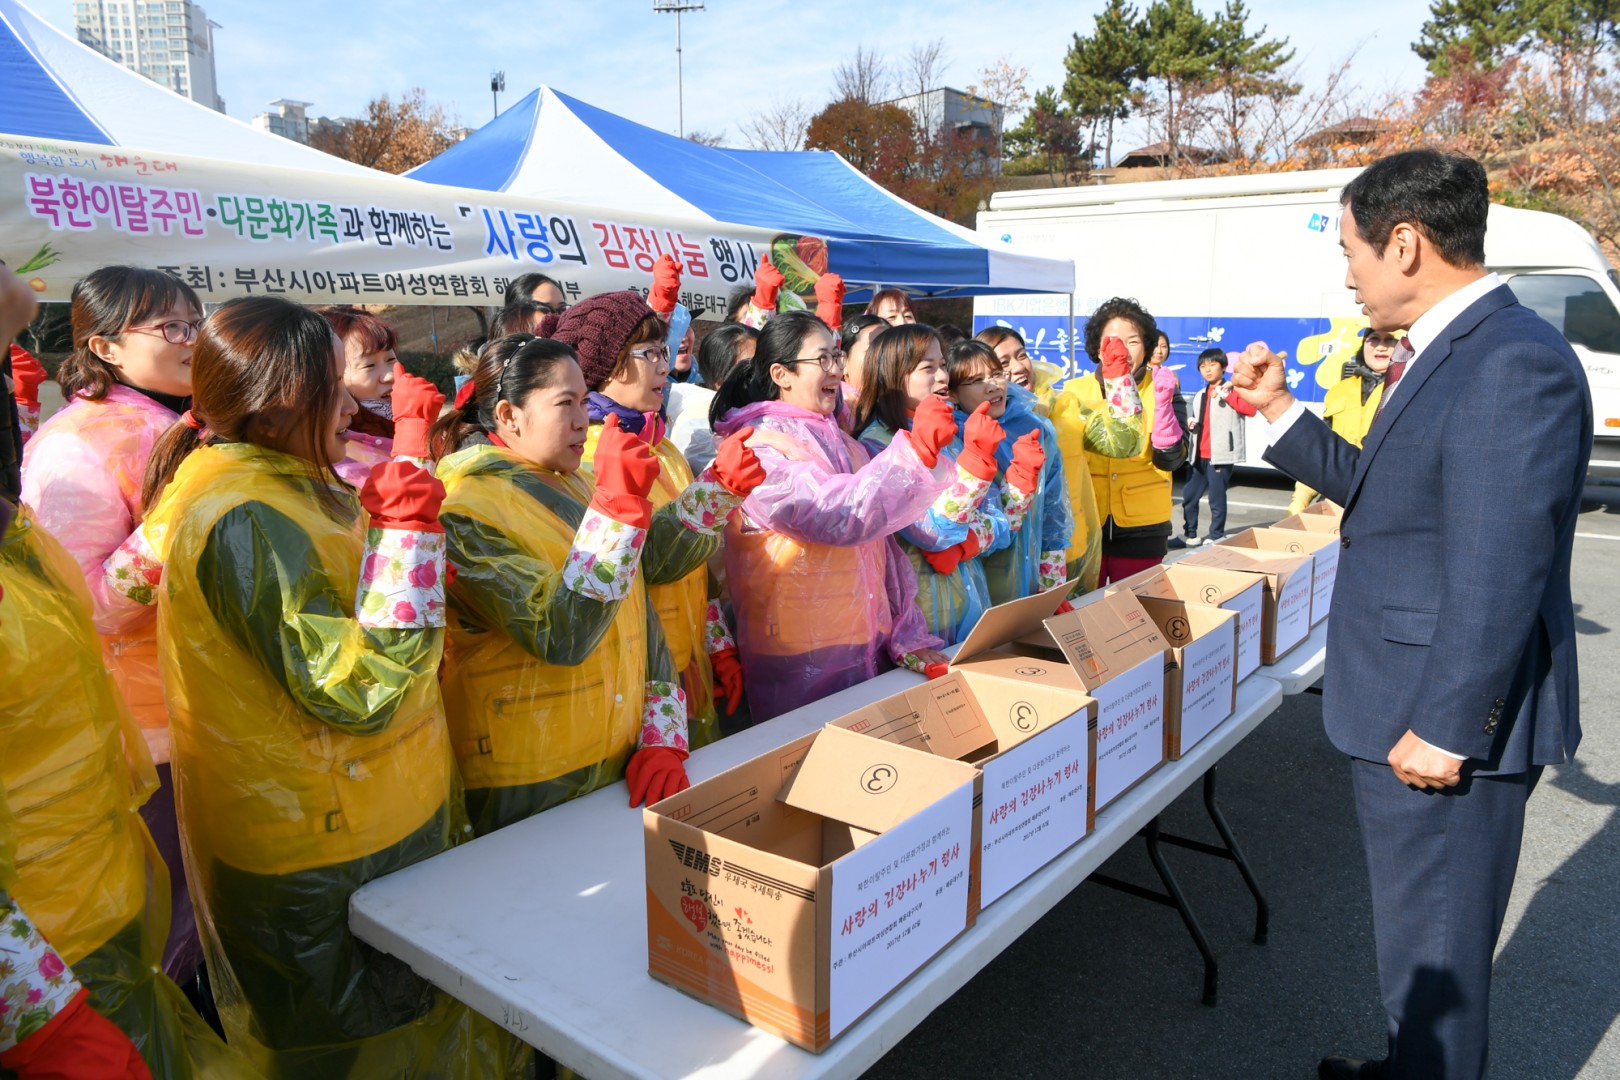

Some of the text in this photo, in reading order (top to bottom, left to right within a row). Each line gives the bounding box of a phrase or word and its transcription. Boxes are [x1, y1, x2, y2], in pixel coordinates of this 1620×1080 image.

[20, 151, 97, 171] 행복한 도시
[100, 153, 178, 176] 해운대
[368, 207, 452, 250] 함께하는
[592, 222, 709, 278] 김장나눔
[709, 237, 758, 283] 행사
[234, 267, 490, 298] 부산시아파트여성연합회
[990, 797, 1016, 824] 사랑의
[1021, 770, 1061, 807] 김장나누기
[1064, 759, 1079, 779] 행사
[683, 846, 721, 877] EMS
[700, 889, 723, 906] 당신이
[724, 872, 782, 901] 우체국 국제특송
[841, 899, 878, 936] 사랑의
[884, 858, 937, 909] 김장나누기
[941, 842, 960, 868] 행사
